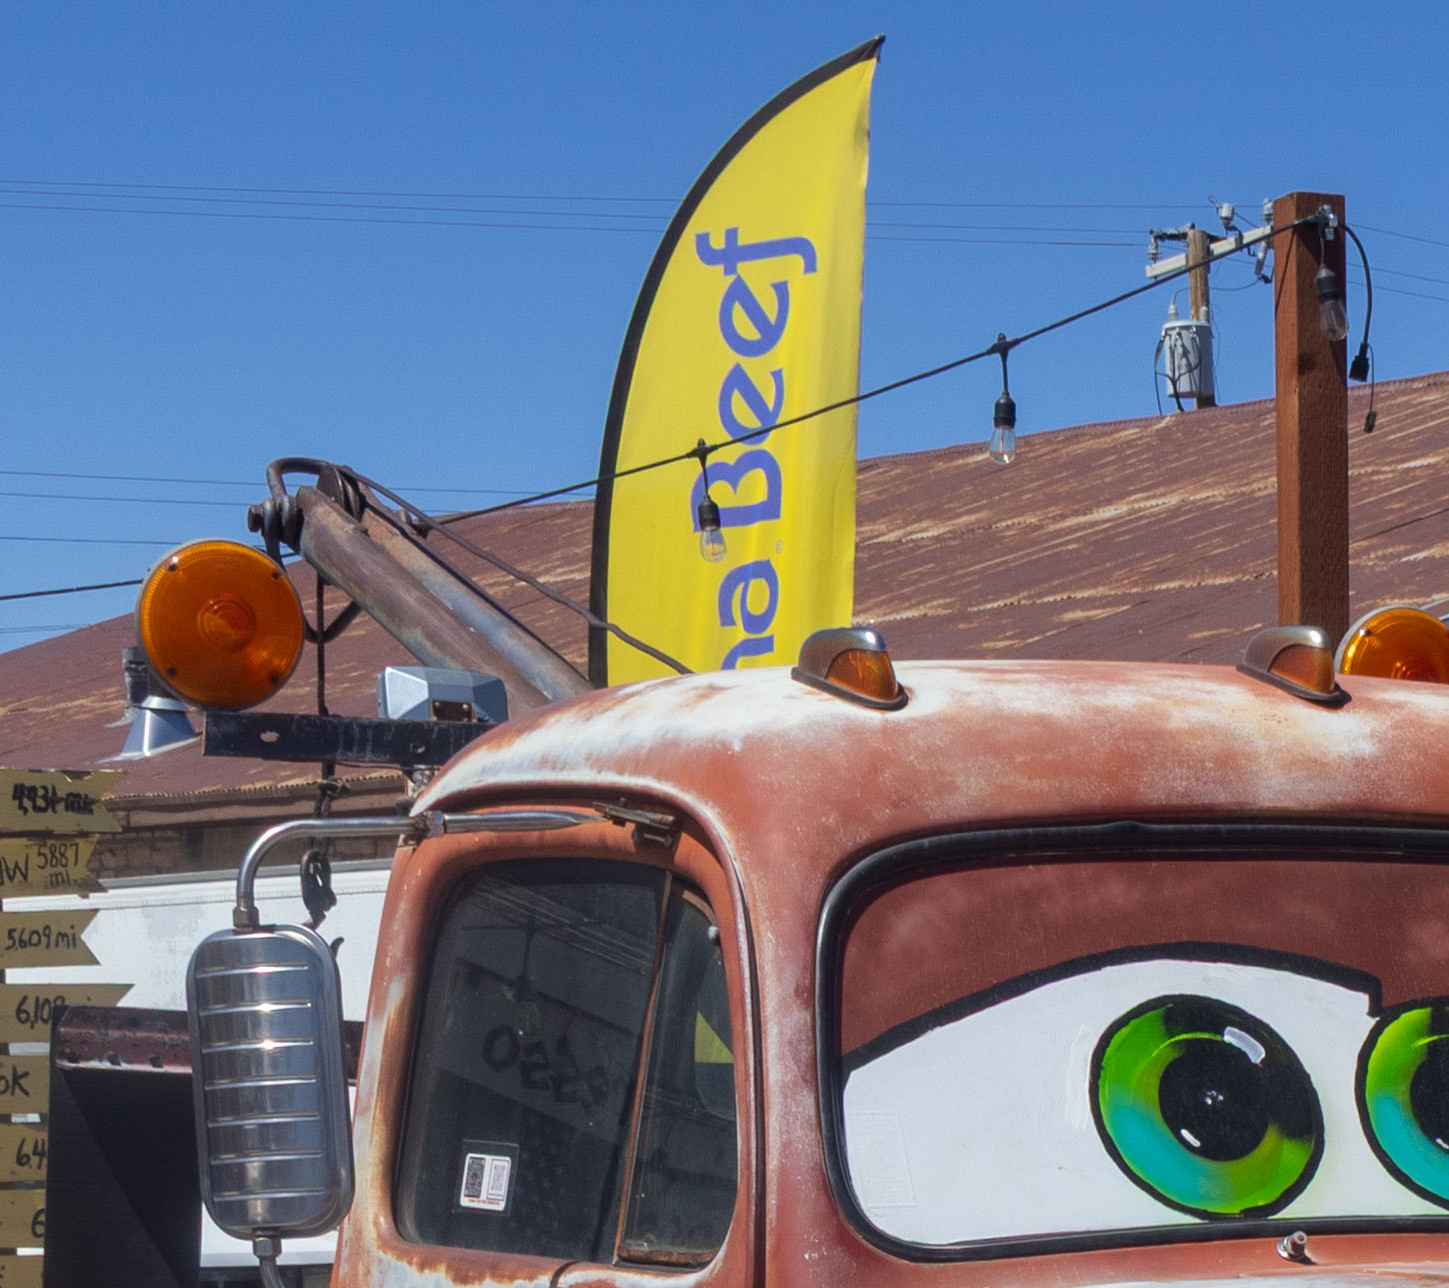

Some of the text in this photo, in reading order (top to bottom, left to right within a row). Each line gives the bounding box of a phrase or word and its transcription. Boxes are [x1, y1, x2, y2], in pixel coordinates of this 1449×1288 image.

[690, 227, 817, 534] Beef
[37, 843, 80, 870] 5887
[55, 925, 78, 949] mi
